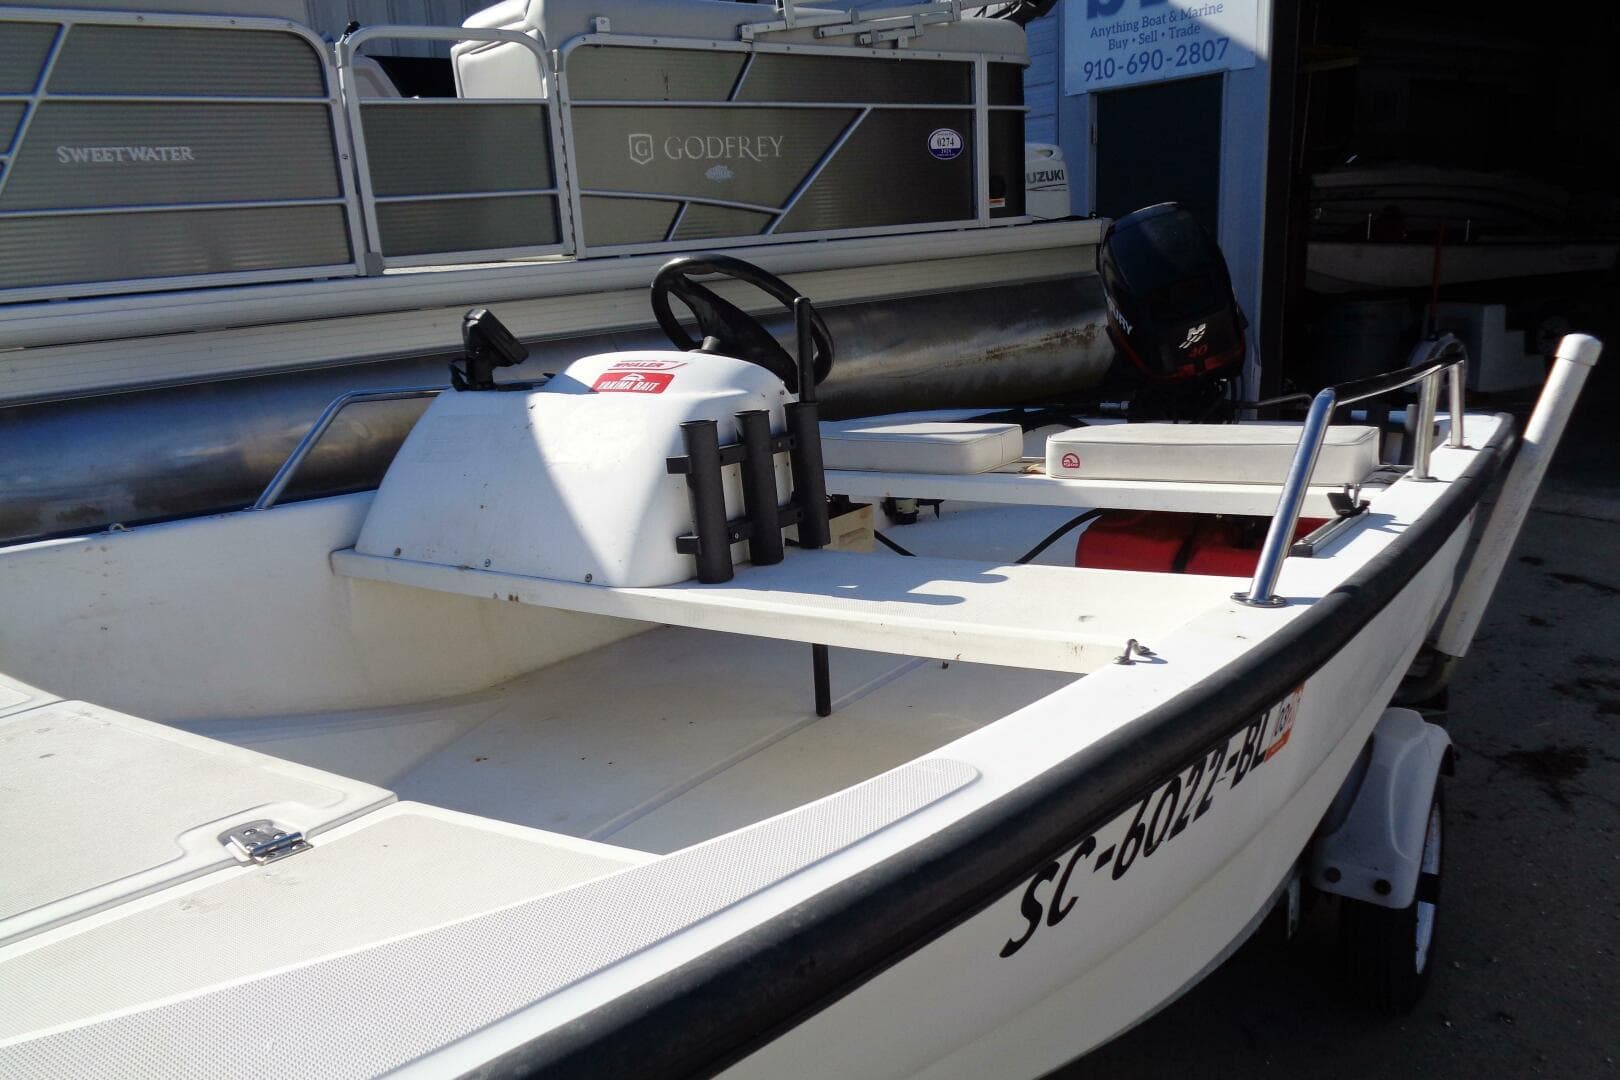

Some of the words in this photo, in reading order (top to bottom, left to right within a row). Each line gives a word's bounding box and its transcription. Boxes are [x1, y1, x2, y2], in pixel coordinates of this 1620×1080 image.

[1090, 19, 1139, 38] Anything
[1141, 13, 1167, 28] Boat
[1169, 11, 1177, 23] &
[1180, 2, 1224, 20] Marine
[1108, 38, 1129, 51] Buy
[1138, 30, 1158, 45] Sell
[1168, 23, 1201, 40] Trade
[1083, 37, 1230, 82] 910-690-2807
[664, 135, 784, 161] GODFREY
[1026, 169, 1065, 184] UZUKI
[597, 380, 633, 391] YAKIMA
[632, 381, 661, 392] BAIT
[999, 708, 1272, 958] SC-6022-BL
